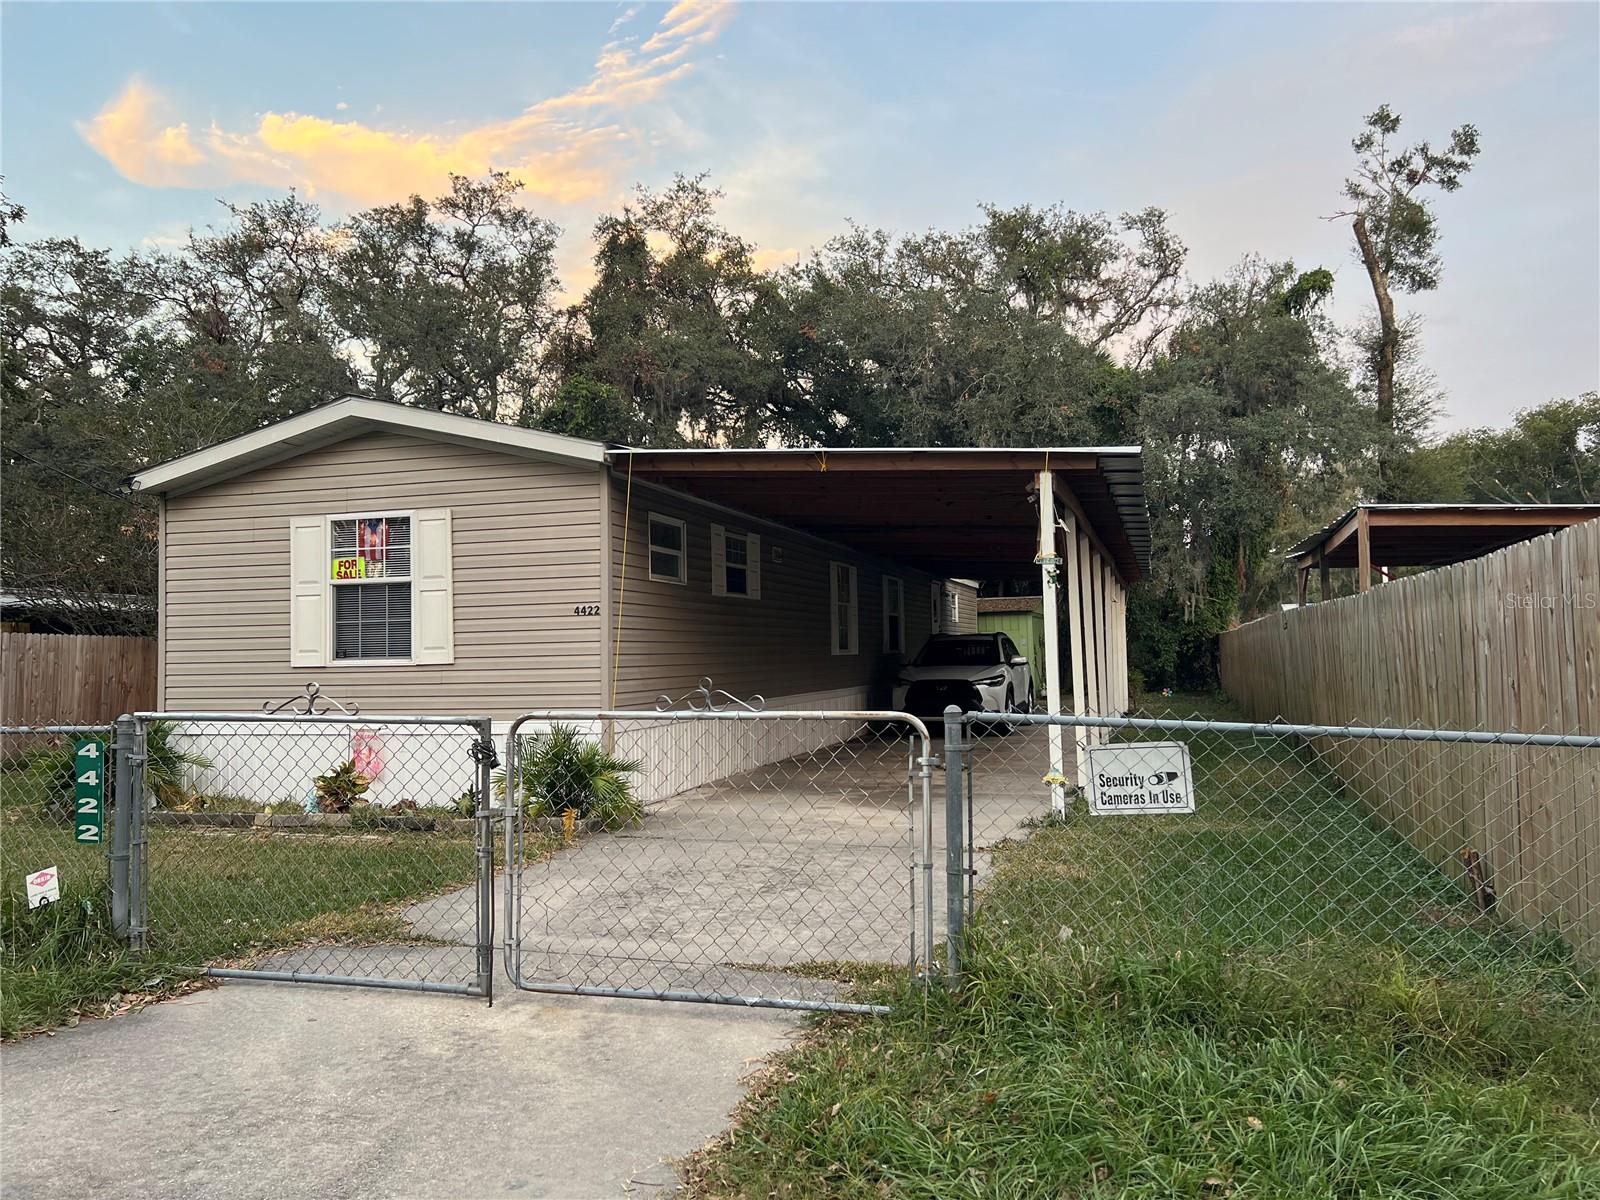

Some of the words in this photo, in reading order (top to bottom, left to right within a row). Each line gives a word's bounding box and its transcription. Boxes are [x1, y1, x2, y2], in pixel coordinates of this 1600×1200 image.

[338, 559, 357, 570] FOR
[574, 605, 601, 616] 4422
[1099, 772, 1144, 789] Security
[77, 742, 100, 841] 4422
[1100, 791, 1146, 806] Cameras
[1149, 790, 1159, 804] In
[1162, 789, 1182, 804] Use
